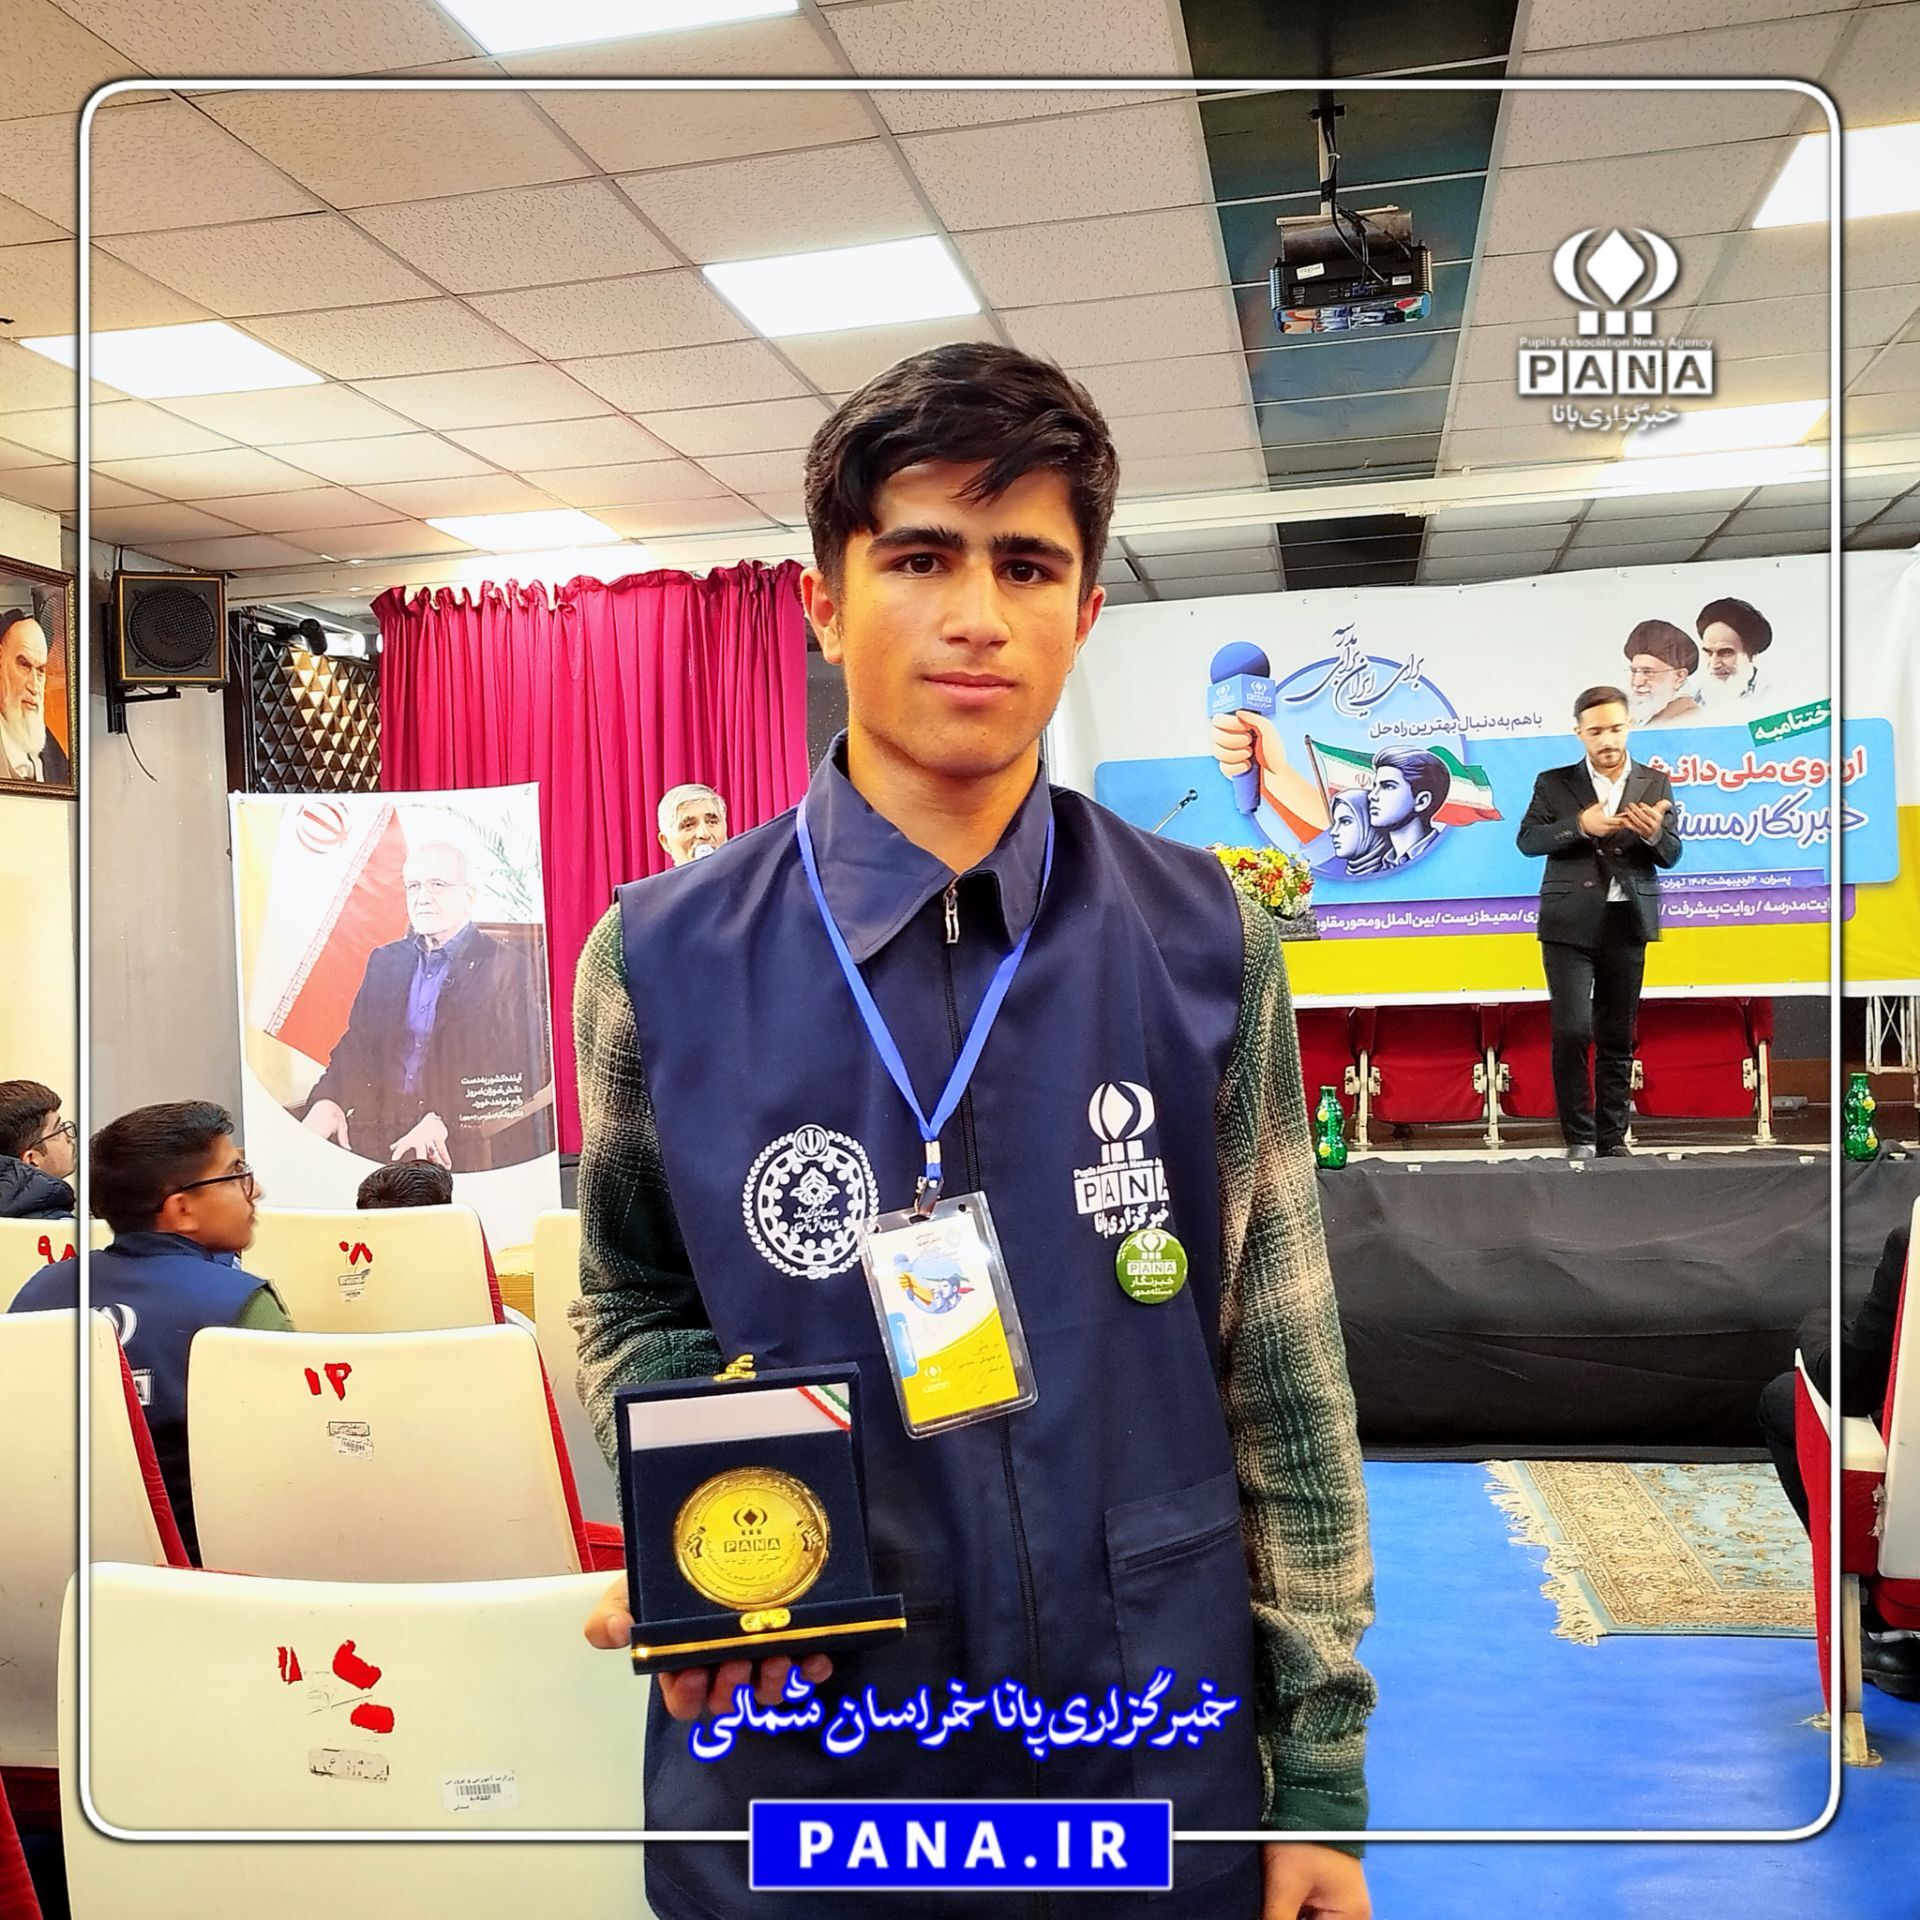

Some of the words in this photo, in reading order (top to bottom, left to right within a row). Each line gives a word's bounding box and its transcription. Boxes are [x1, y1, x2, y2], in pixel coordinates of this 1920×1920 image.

[1370, 721, 1393, 739] حل
[1393, 720, 1408, 737] راه
[1409, 718, 1458, 737] بهترین
[1458, 715, 1496, 732] دنبال
[1497, 718, 1510, 731] به
[1755, 703, 1832, 742] ختتامیه
[1720, 753, 1778, 789] ملی
[1780, 748, 1865, 784] اروی
[1668, 899, 1721, 920] پیشرفت
[1720, 901, 1756, 917] روایت
[1763, 899, 1808, 915] مدرسه
[1316, 915, 1346, 932] مقاو
[1441, 911, 1479, 926] زیست
[1478, 909, 1518, 924] محیط
[1127, 1261, 1177, 1275] PANA
[724, 1538, 781, 1553] PANA
